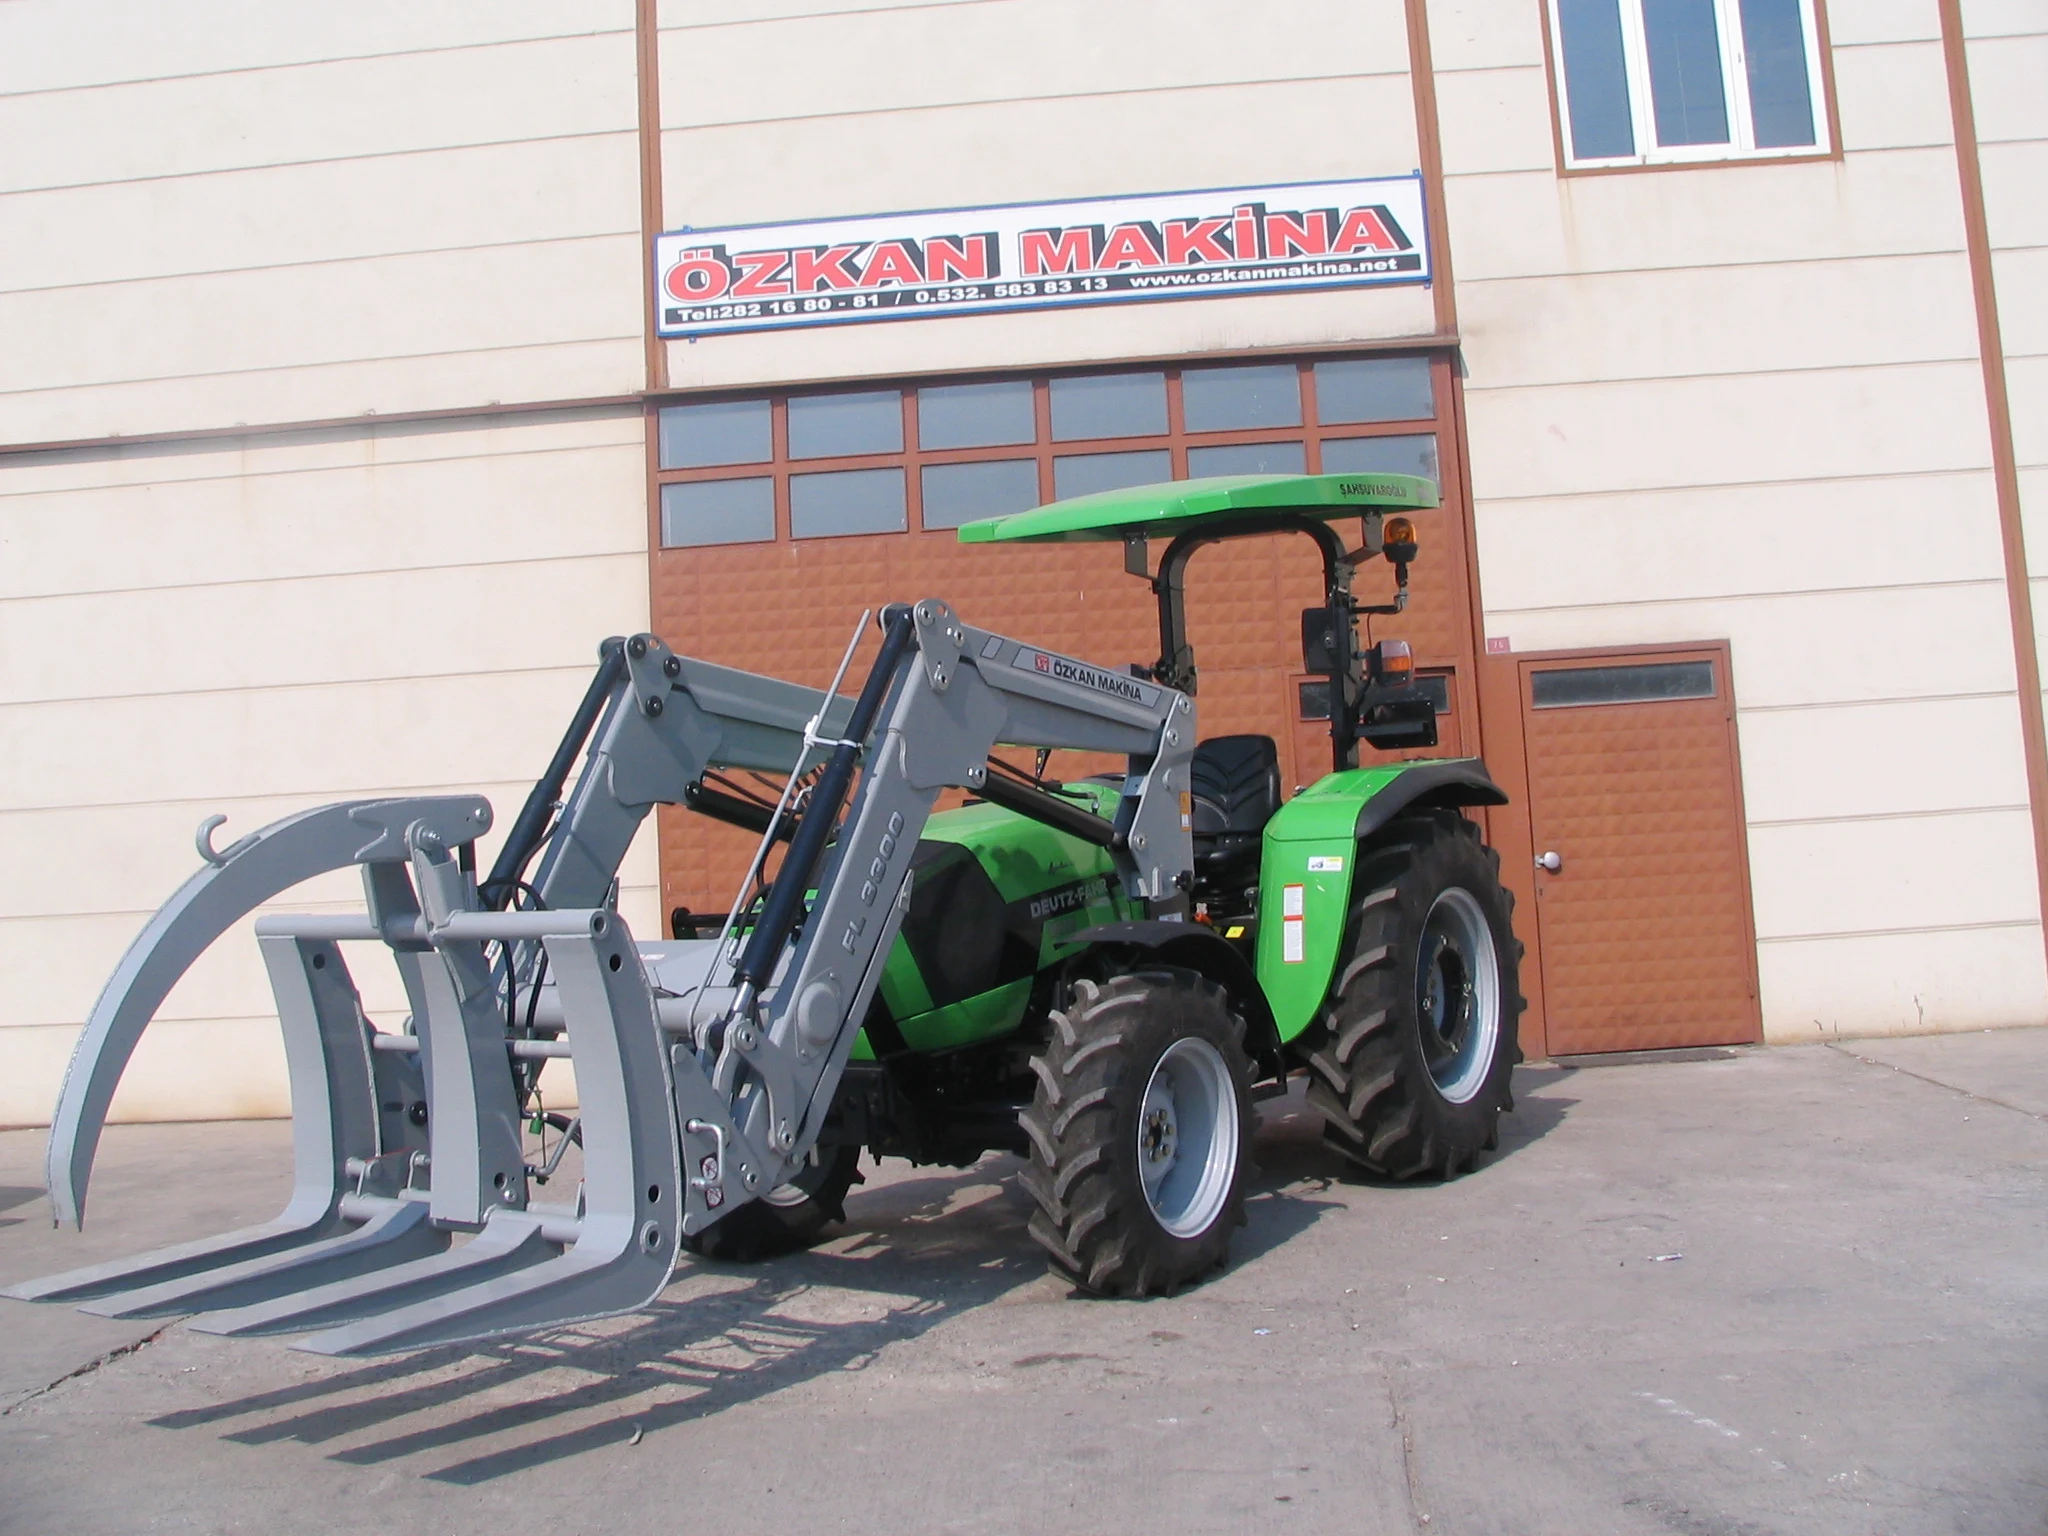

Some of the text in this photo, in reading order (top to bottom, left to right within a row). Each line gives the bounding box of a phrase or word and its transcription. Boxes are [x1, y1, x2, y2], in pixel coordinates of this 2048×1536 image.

[665, 202, 1414, 303] ÖZKAN MAKİNA
[677, 303, 762, 322] Tel:282
[769, 301, 797, 315] 16
[803, 298, 832, 312] 80
[852, 294, 879, 308] 81
[915, 286, 986, 304] 0.532.
[994, 282, 1037, 298] 583
[1044, 280, 1072, 294] 83
[1080, 277, 1109, 291] 13
[1129, 257, 1398, 288] www.ozkanmakina.net
[1053, 658, 1096, 687] ÖZKAN
[1098, 674, 1142, 701] MAKİNA
[841, 810, 905, 956] FL 3300
